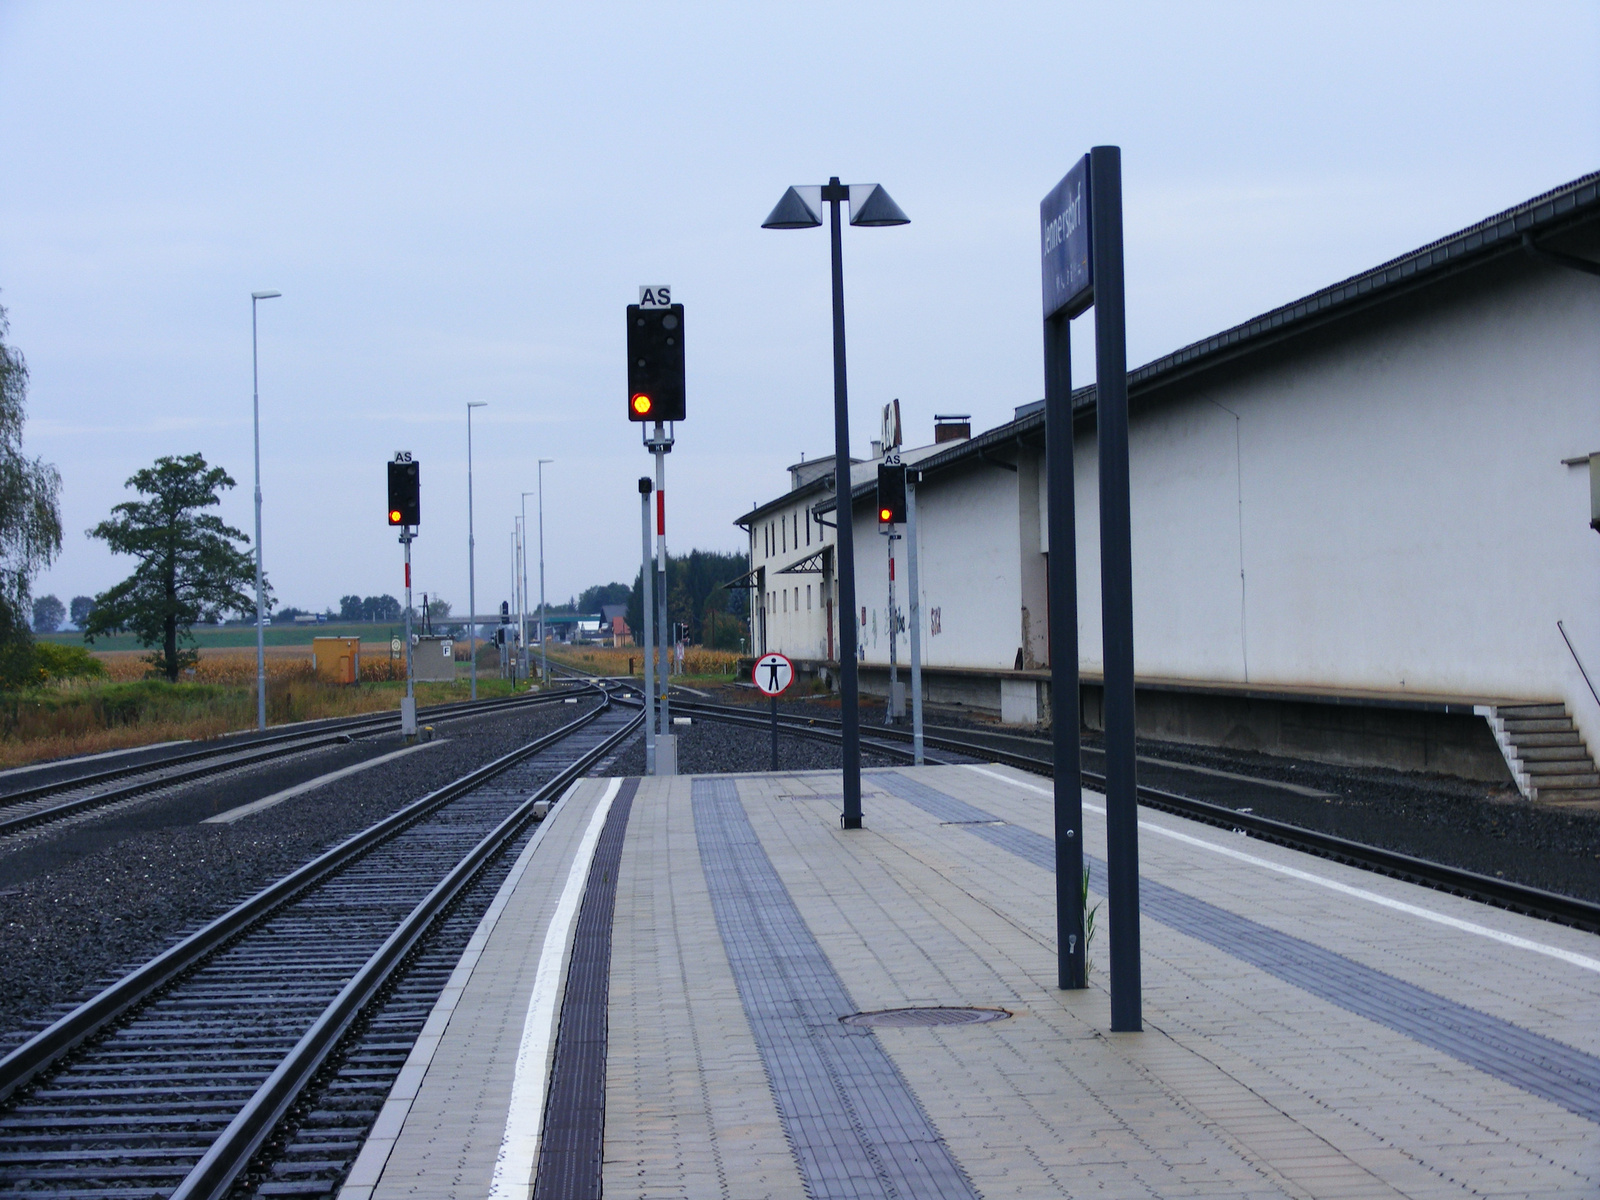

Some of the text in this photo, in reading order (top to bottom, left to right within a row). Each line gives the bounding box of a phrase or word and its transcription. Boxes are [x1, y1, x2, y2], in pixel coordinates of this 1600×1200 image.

[641, 288, 671, 306] AS
[395, 452, 412, 462] AS
[885, 455, 900, 465] AS
[444, 647, 450, 655] F
